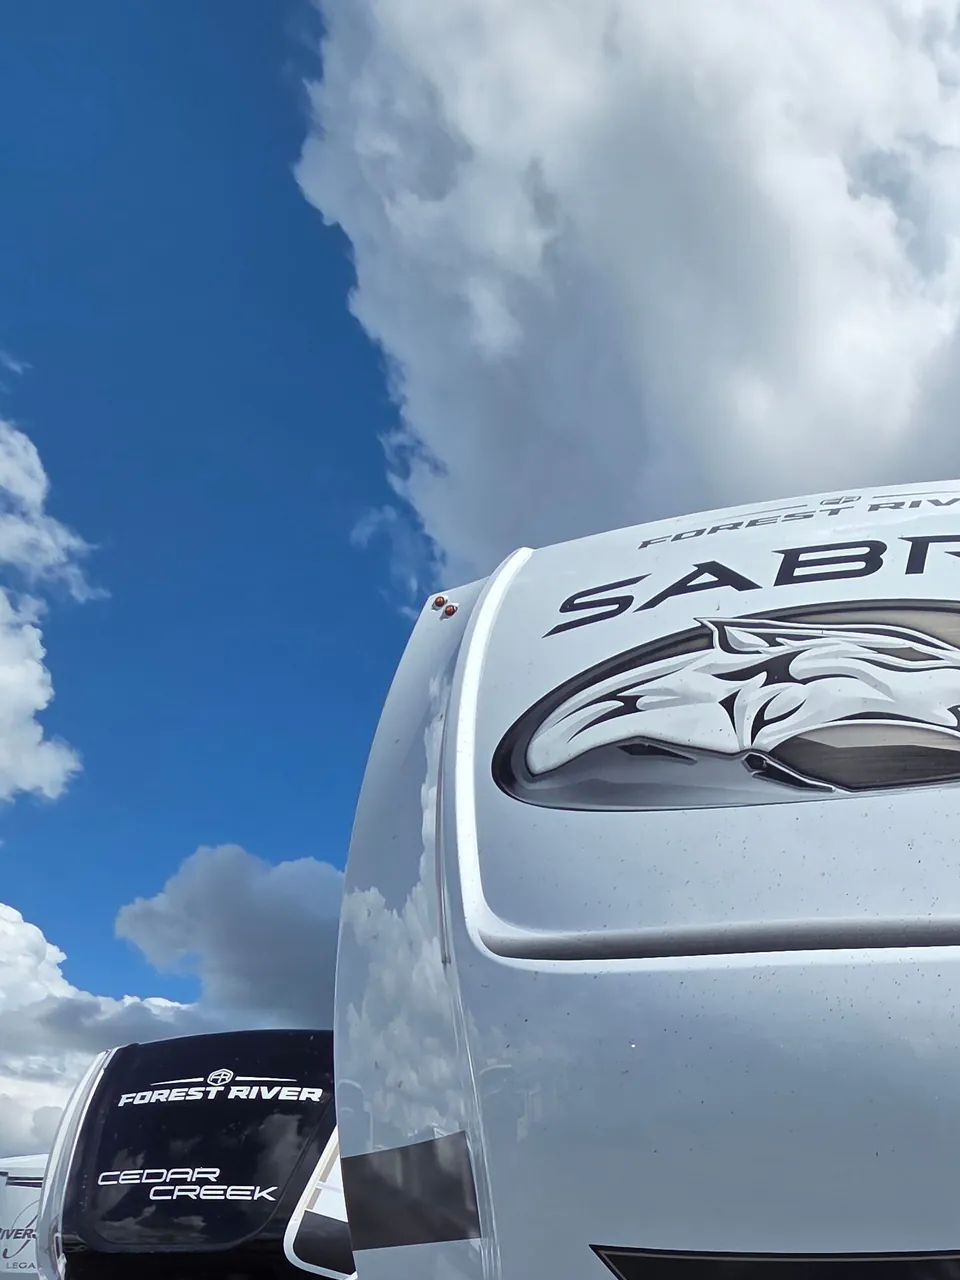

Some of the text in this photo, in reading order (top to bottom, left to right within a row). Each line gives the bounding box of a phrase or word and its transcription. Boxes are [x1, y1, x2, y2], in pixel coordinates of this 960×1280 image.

[638, 506, 855, 549] FOREST
[118, 1086, 323, 1107] FOREST RIVER
[98, 1168, 220, 1186] CEDAR
[150, 1185, 278, 1201] CREEK
[0, 1228, 37, 1240] IVER
